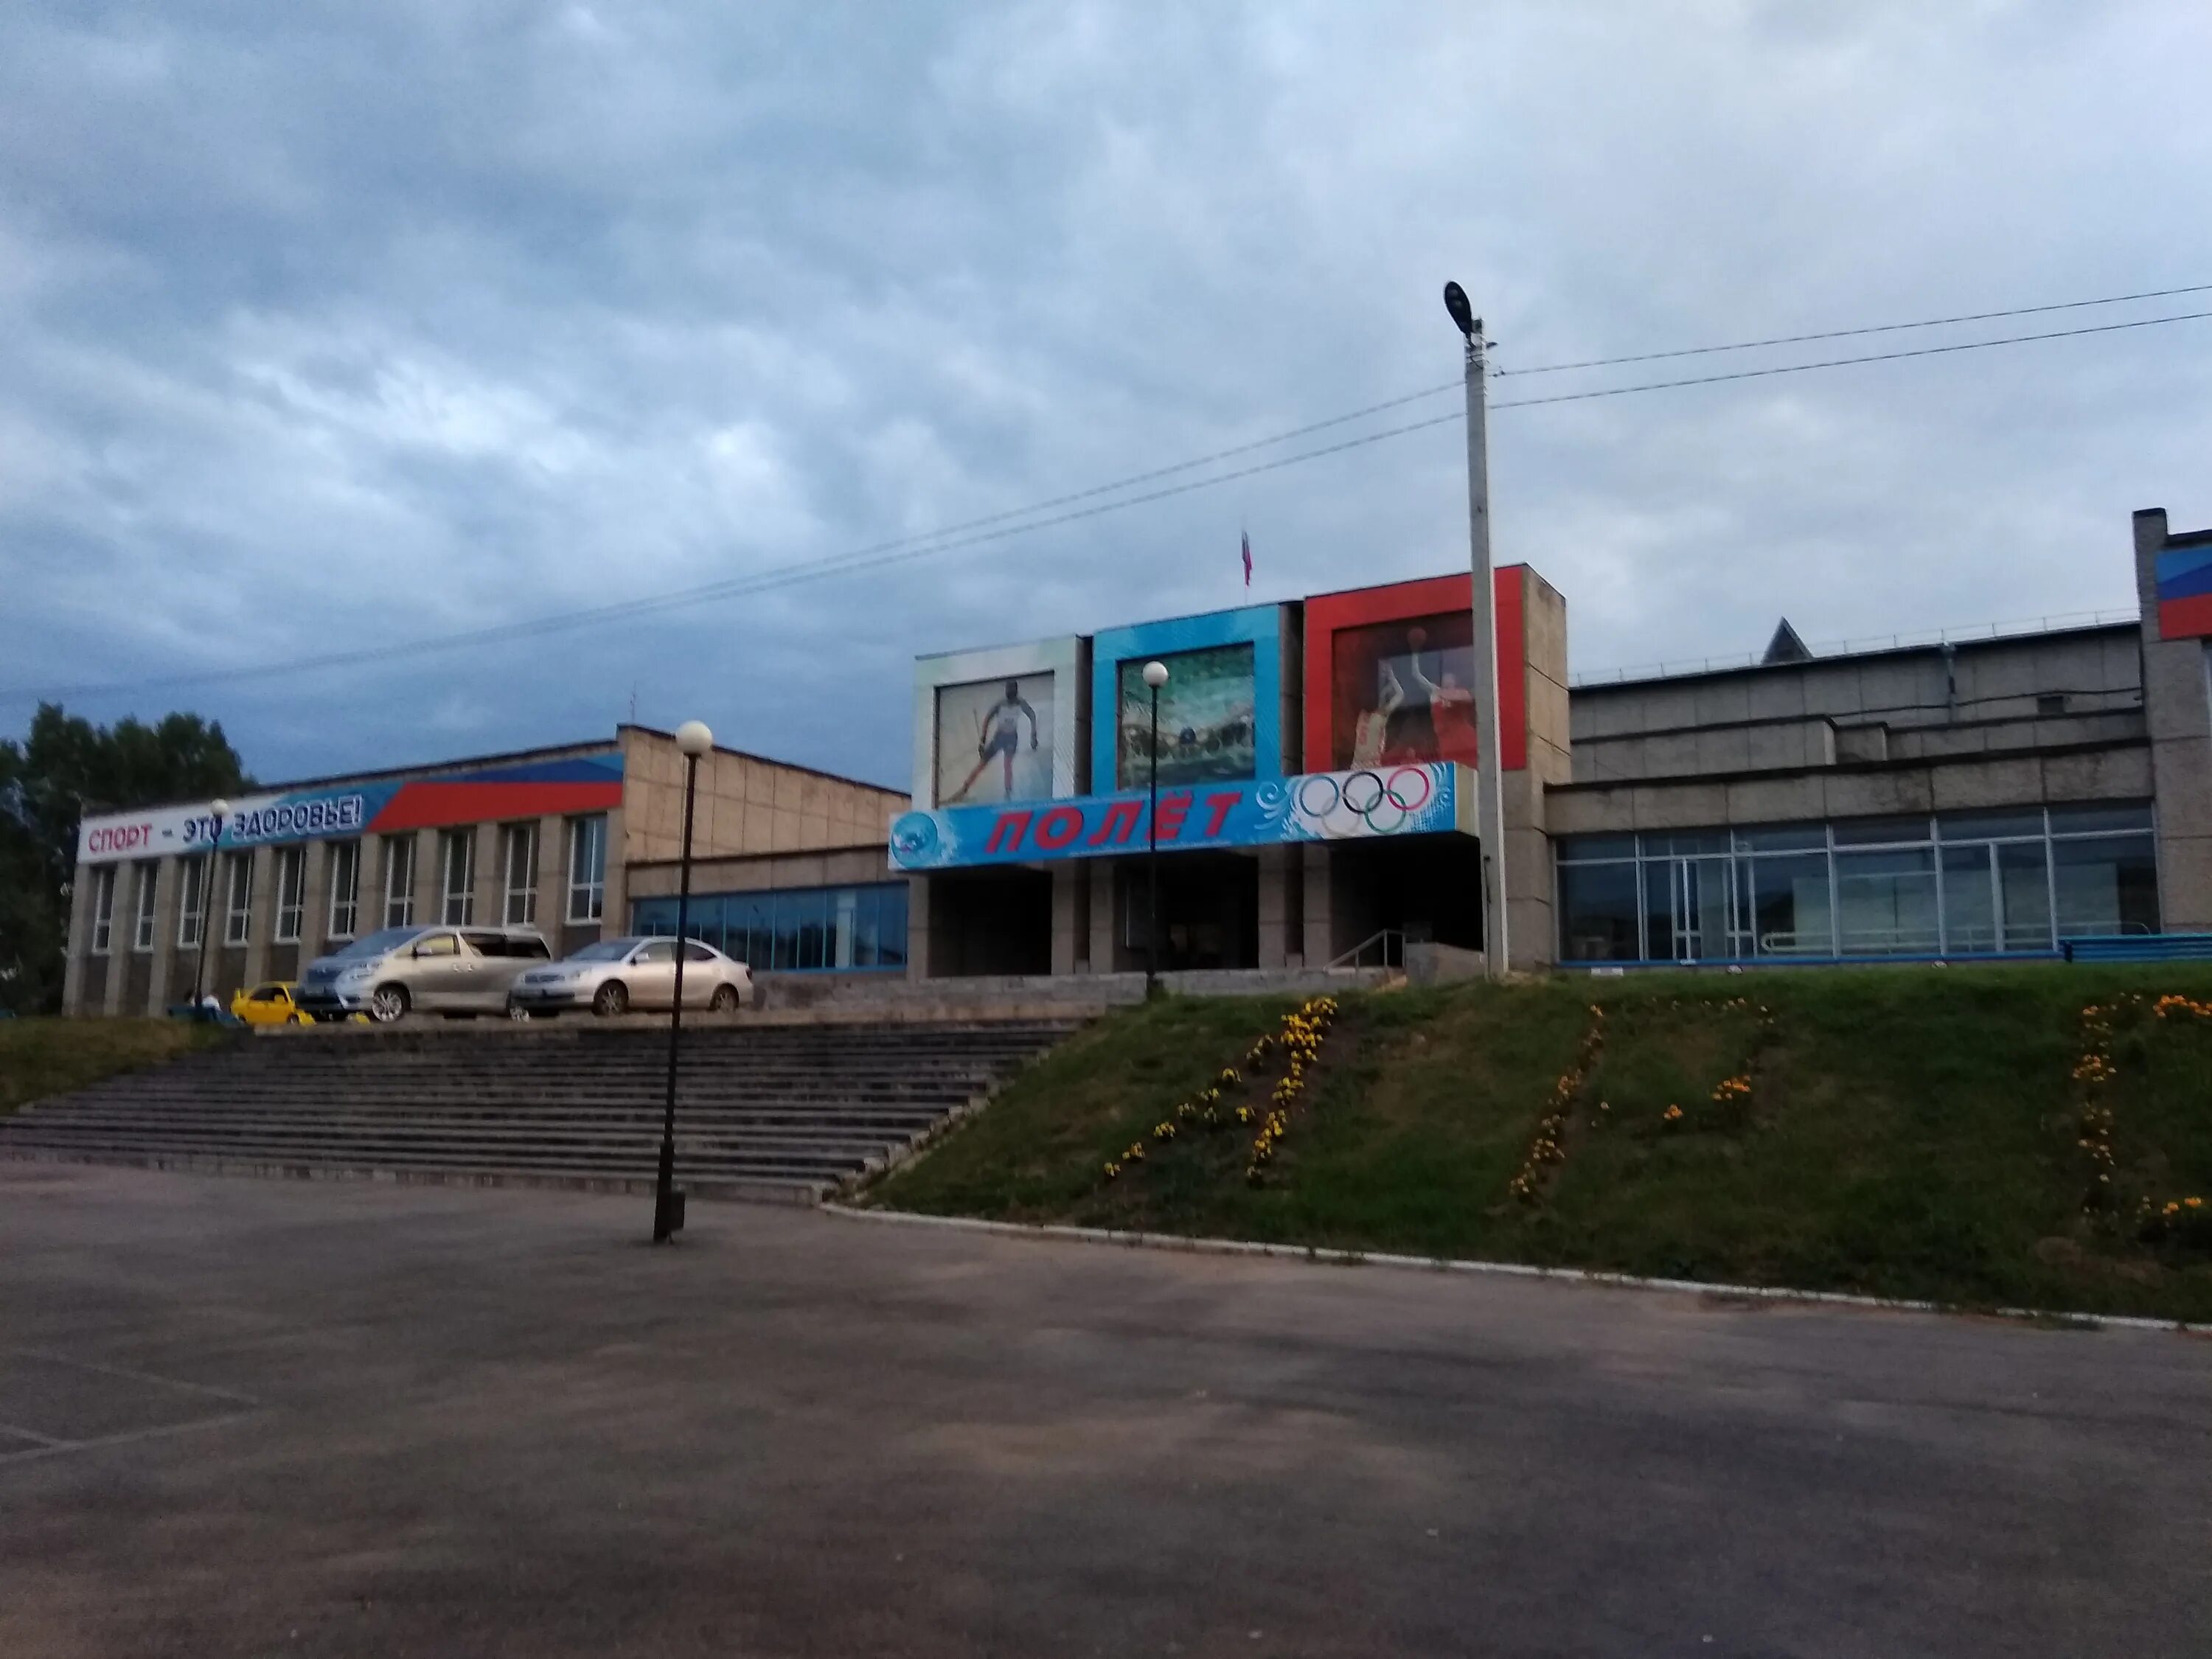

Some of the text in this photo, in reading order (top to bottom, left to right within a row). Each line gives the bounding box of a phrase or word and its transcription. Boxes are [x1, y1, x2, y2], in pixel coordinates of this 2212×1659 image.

[88, 822, 153, 854] СПОРТ
[232, 794, 363, 840] ЗДОРОВЬЕ!
[984, 790, 1242, 854] ПОЛЁТ
